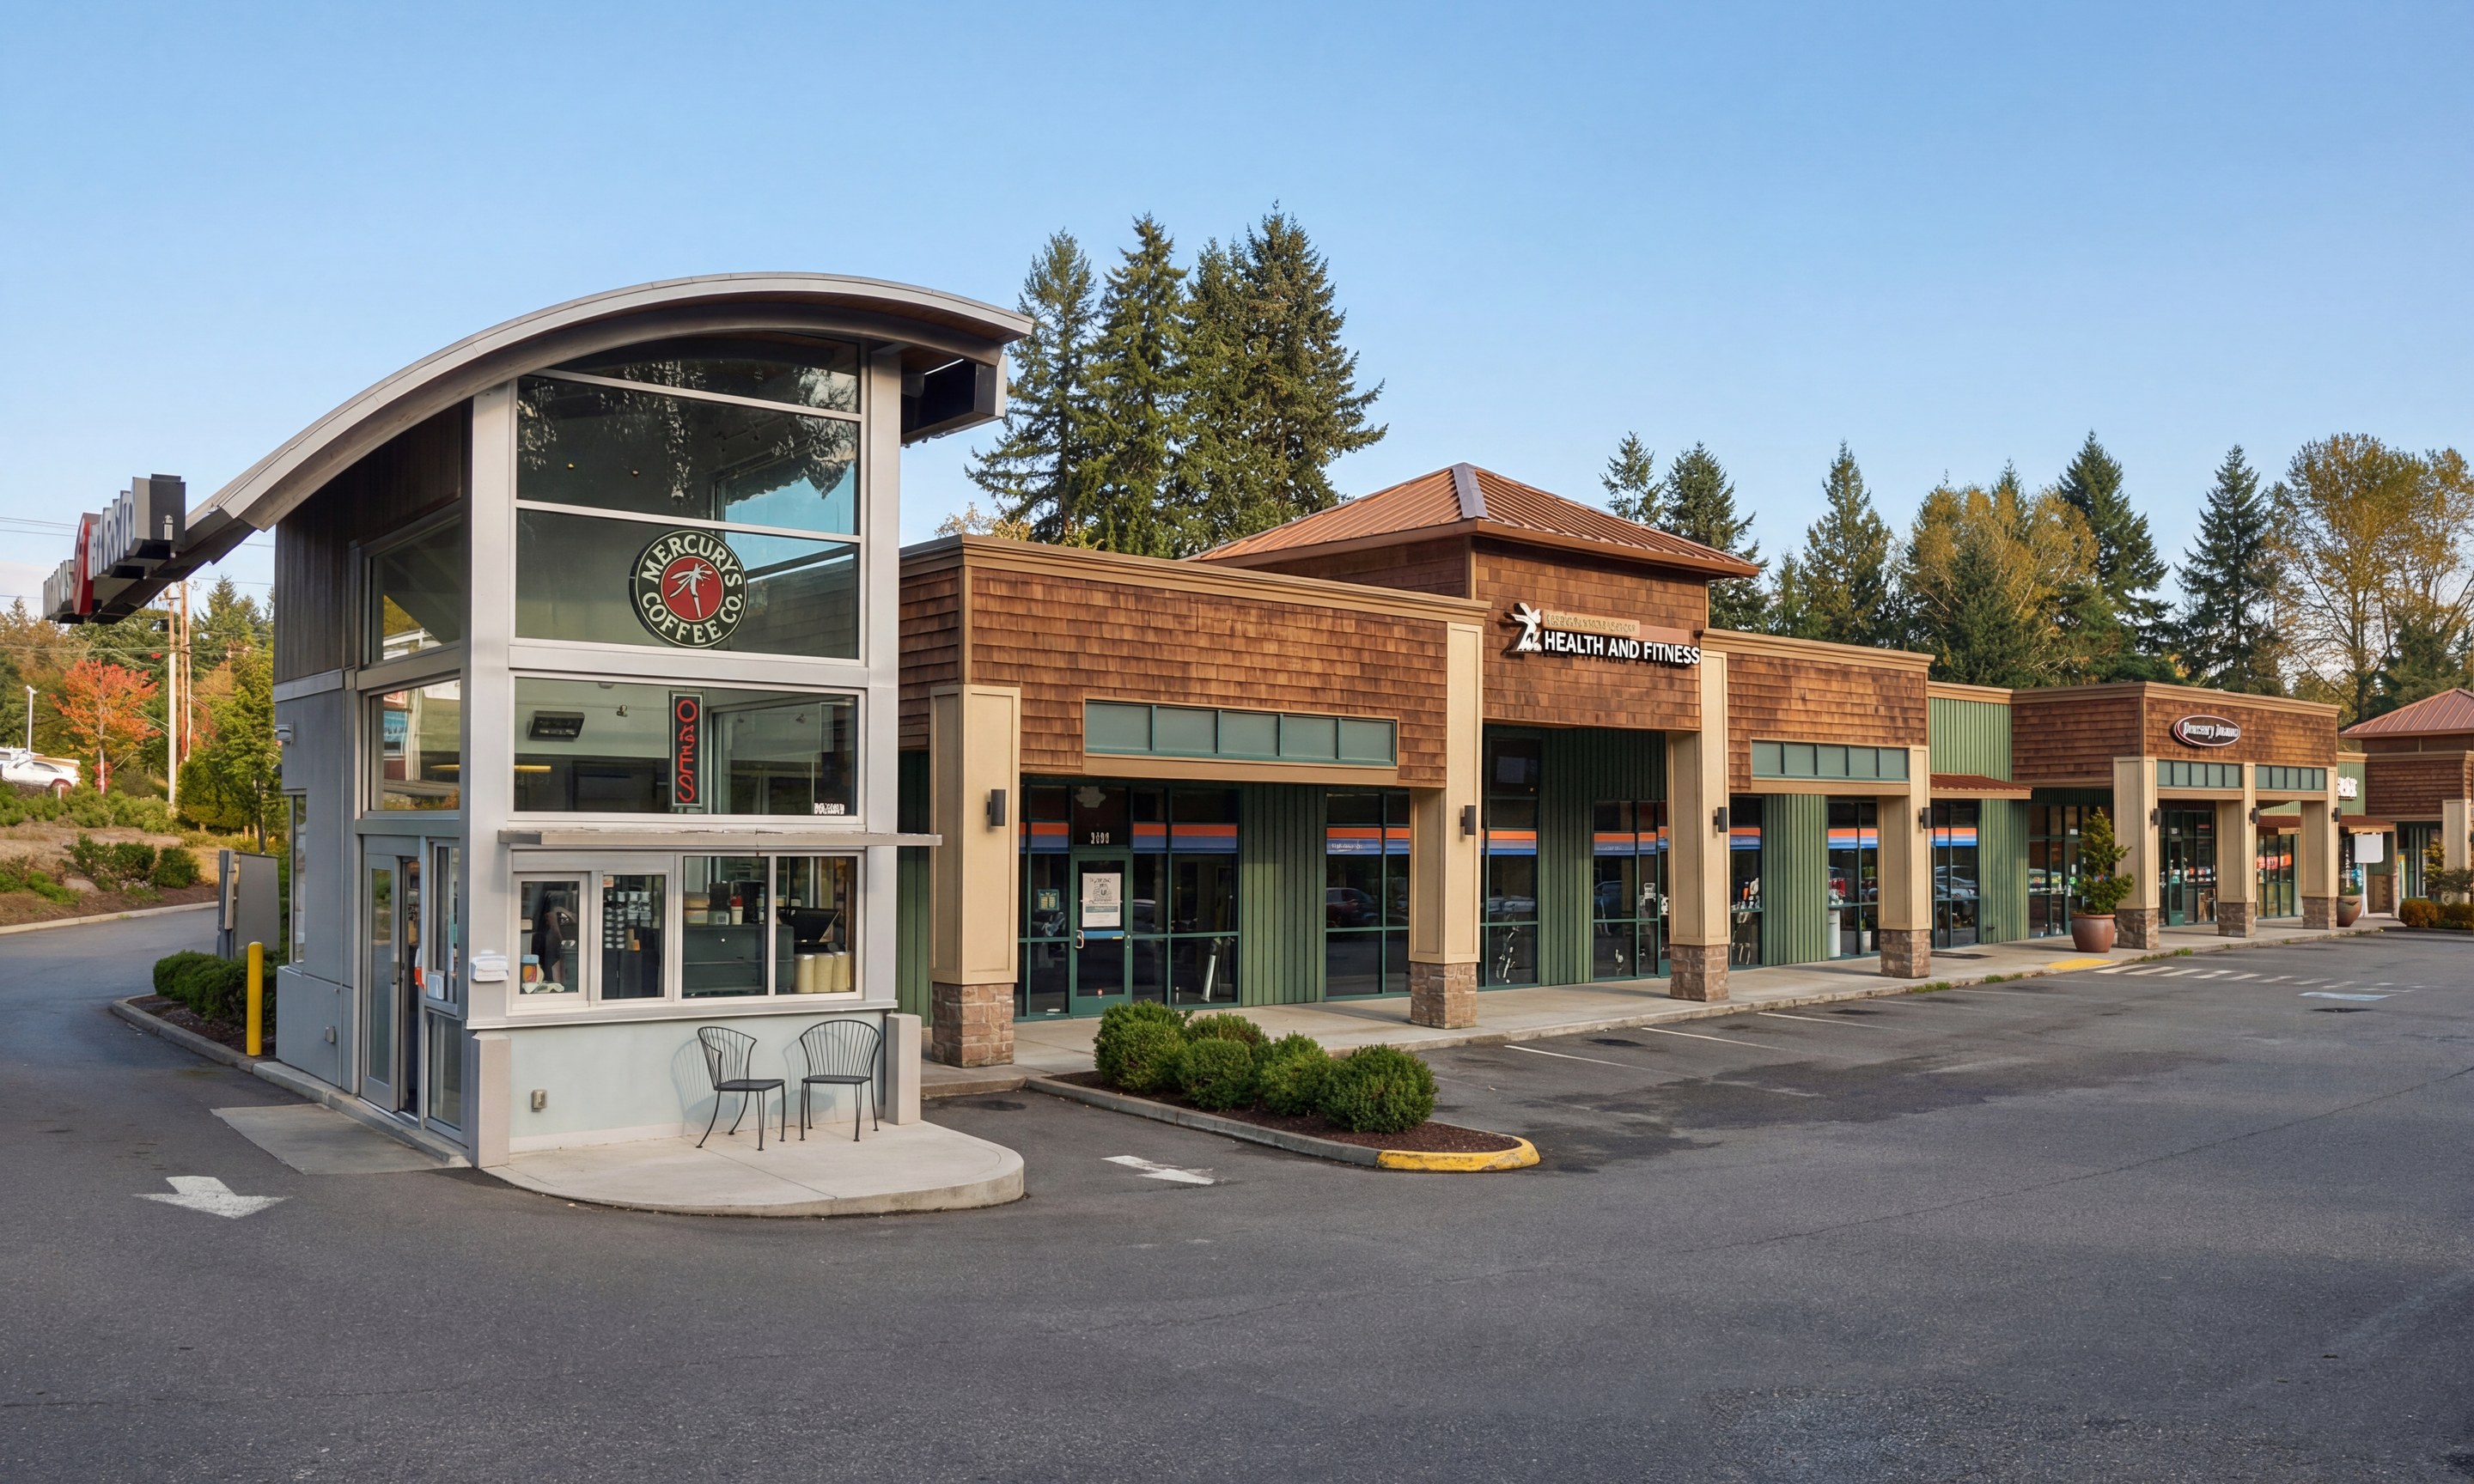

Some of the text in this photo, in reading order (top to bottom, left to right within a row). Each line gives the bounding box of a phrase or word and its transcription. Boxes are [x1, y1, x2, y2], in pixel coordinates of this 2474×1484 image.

[641, 534, 743, 587] MERCURYS
[642, 592, 743, 643] COFFEE CO.
[1545, 630, 1700, 665] HEALTH AND FITNESS
